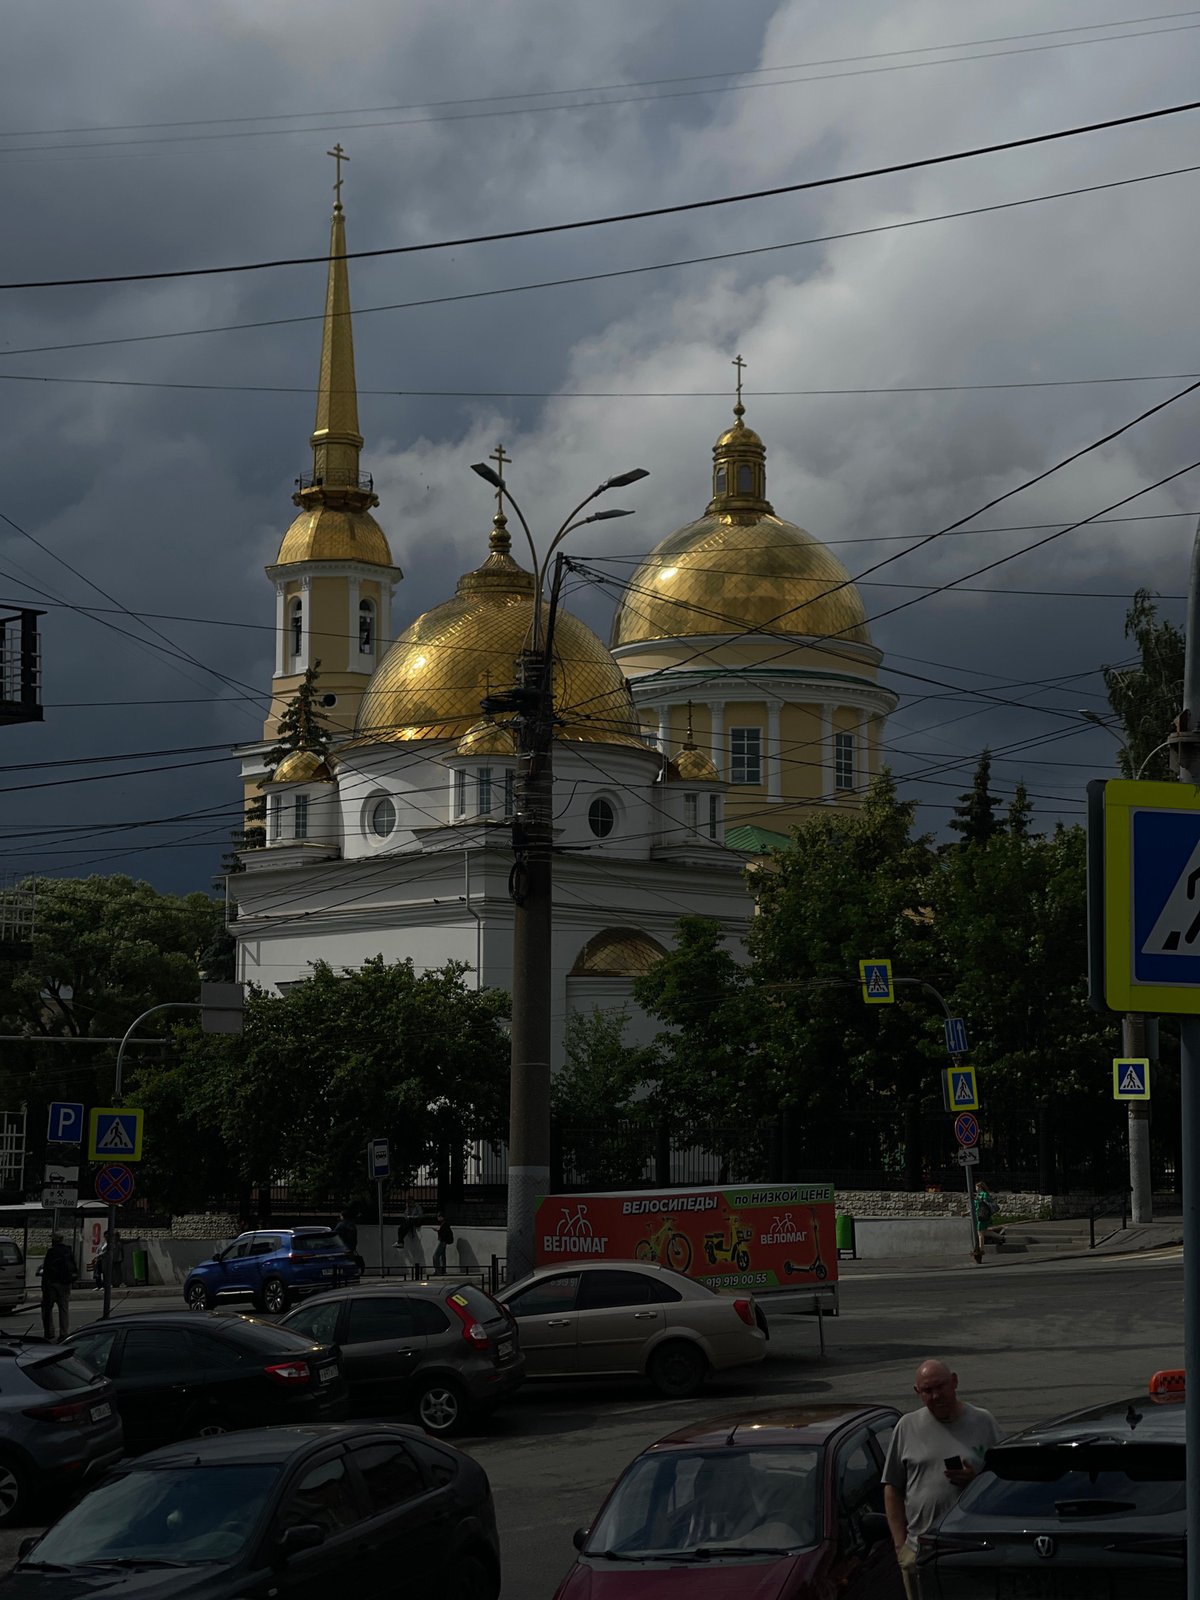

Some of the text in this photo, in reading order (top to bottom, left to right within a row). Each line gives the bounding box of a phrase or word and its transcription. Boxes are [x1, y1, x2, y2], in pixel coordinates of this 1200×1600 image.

[58, 1107, 75, 1137] P
[735, 1188, 830, 1205] по НИЗКОЙ ЦЕНЕ
[622, 1197, 718, 1215] ВЕЛОСИПЕДЫ
[92, 1222, 101, 1246] 9
[760, 1231, 808, 1245] ВЕЛОМАГ
[543, 1235, 609, 1253] ВЕЛОМАГ
[706, 1277, 721, 1287] 919
[723, 1275, 739, 1287] 919
[741, 1275, 754, 1285] 00
[755, 1274, 767, 1283] 55
